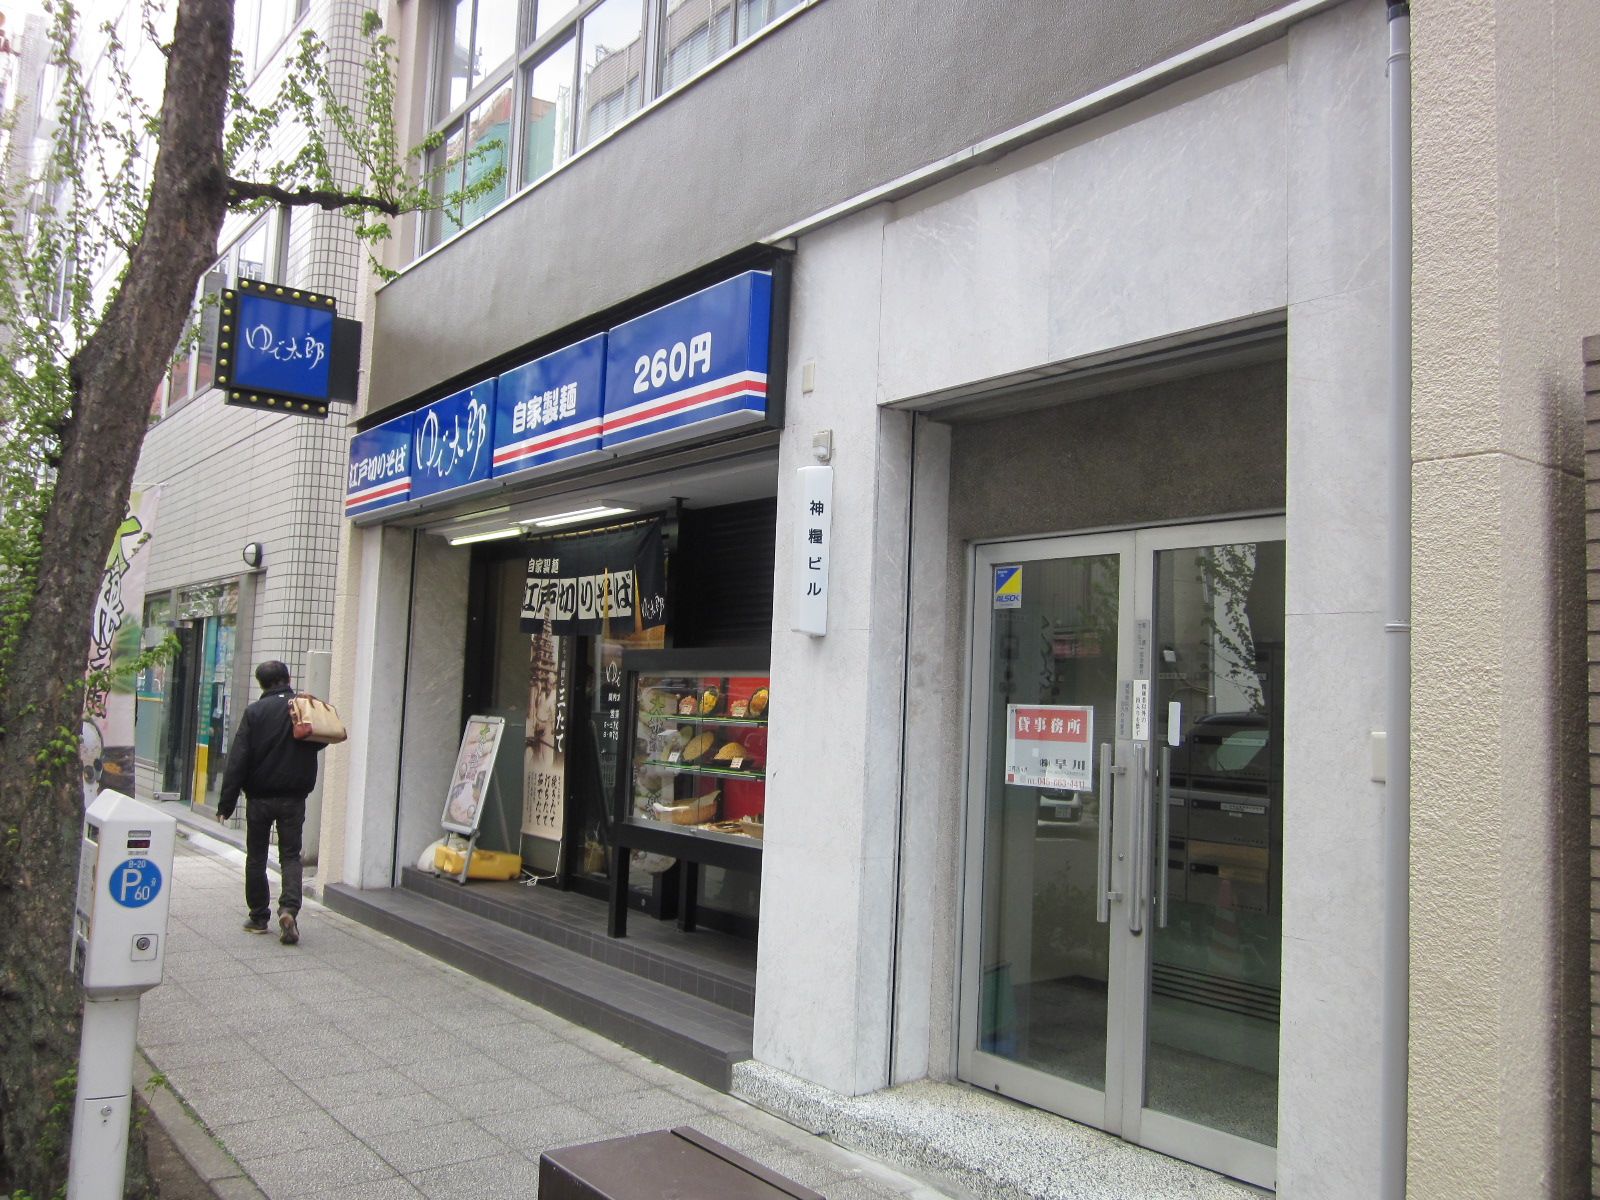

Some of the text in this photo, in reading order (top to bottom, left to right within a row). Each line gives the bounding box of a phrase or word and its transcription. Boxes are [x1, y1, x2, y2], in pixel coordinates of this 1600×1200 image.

[245, 323, 325, 370] ゆで太郎
[633, 331, 712, 394] 260円
[512, 382, 578, 434] 自家製麺
[415, 391, 487, 480] ゆで太郎
[348, 444, 407, 488] 江戸切りそば
[527, 558, 560, 574] 自家製麺
[521, 573, 632, 615] 江戸切りそば
[1018, 716, 1081, 735] 貸事務所
[120, 868, 142, 901] P
[134, 885, 151, 901] 60
